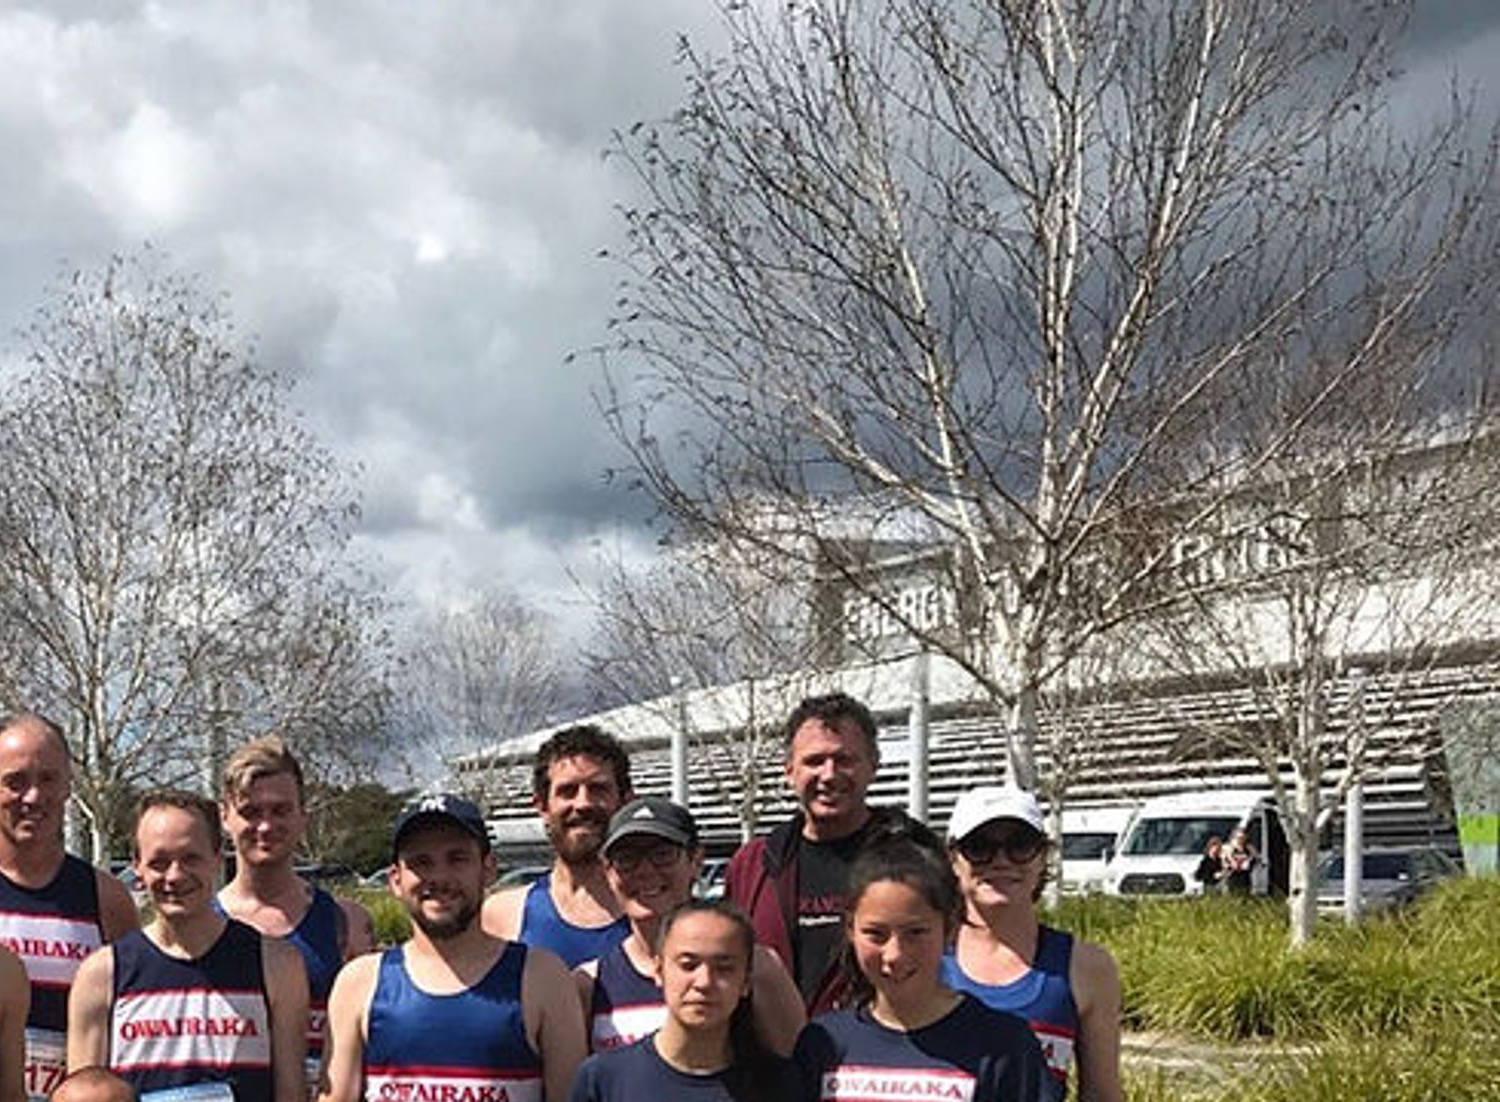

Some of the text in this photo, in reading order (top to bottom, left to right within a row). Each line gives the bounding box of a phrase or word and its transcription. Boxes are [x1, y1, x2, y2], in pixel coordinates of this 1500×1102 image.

[6, 938, 91, 961] AIRAK
[120, 1017, 257, 1040] OWAIRAKA
[25, 1063, 67, 1093] 17
[827, 1077, 963, 1099] OWAIRAKA
